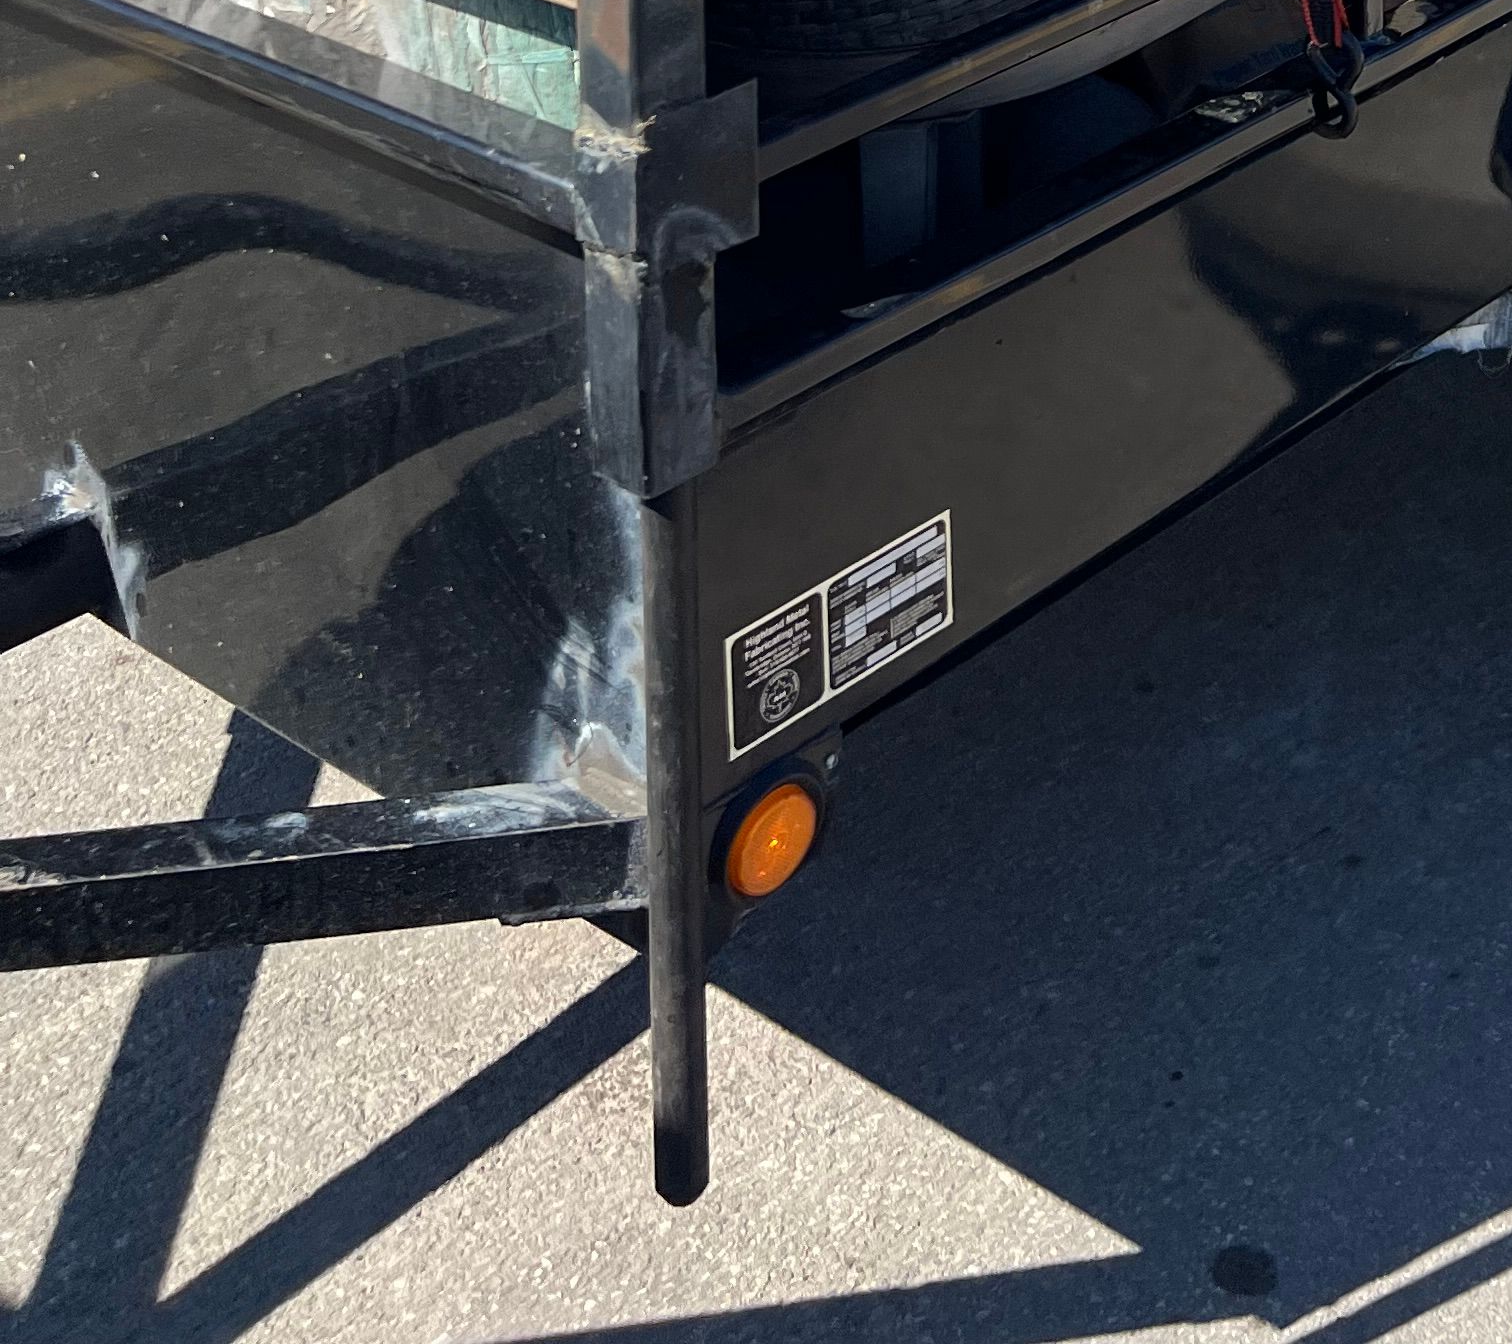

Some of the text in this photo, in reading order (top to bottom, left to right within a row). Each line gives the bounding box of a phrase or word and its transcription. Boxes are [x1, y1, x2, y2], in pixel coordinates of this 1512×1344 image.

[744, 627, 794, 662] Fabricating
[745, 603, 809, 648] Highland Metal
